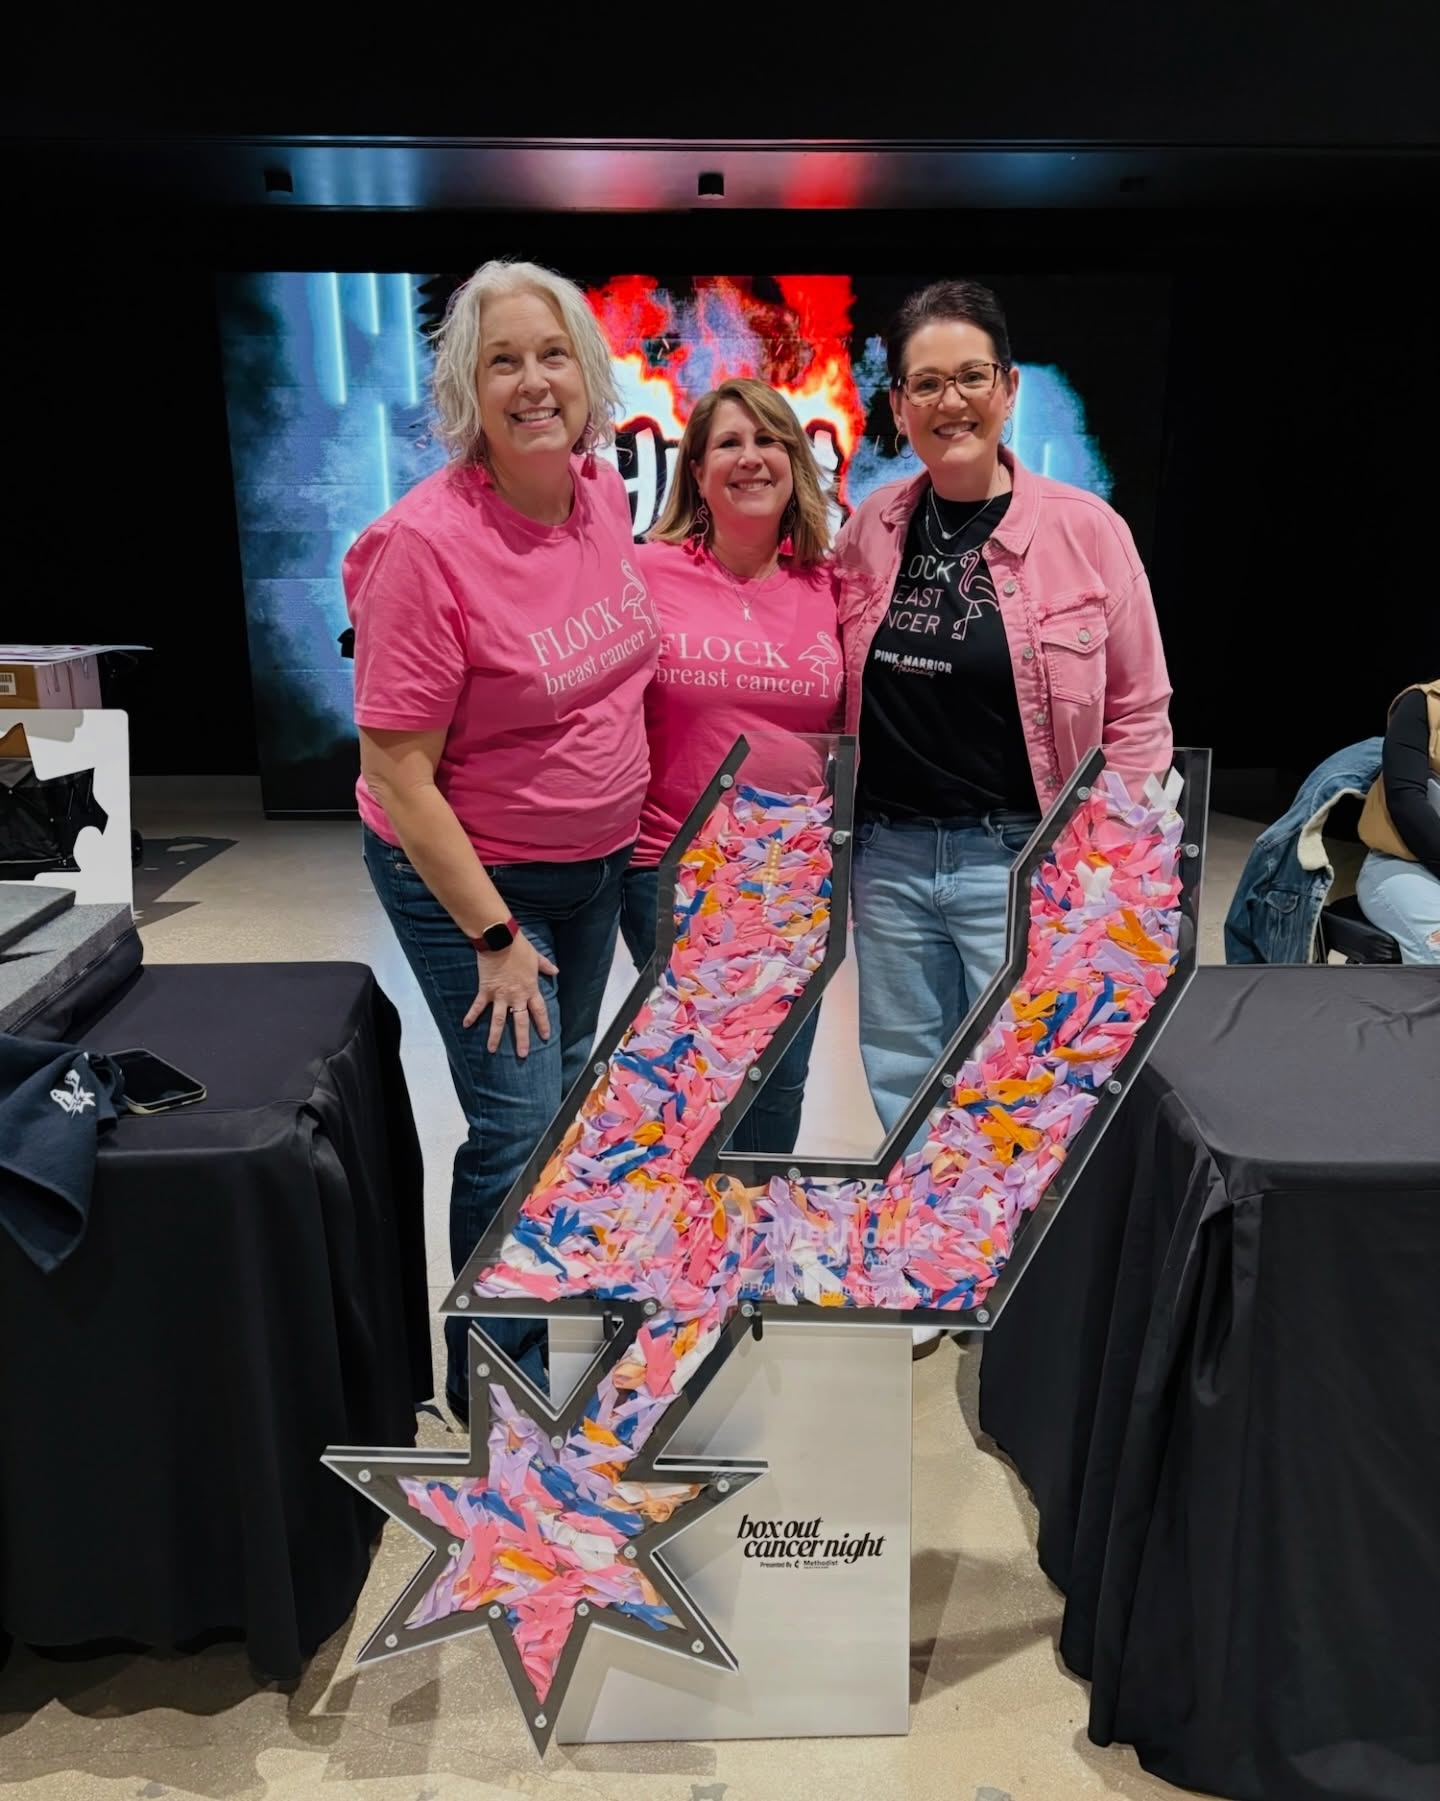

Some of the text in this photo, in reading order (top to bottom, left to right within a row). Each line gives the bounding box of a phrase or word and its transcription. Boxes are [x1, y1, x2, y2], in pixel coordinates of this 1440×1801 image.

[899, 555, 956, 583] OCK
[892, 584, 945, 609] EAST
[528, 597, 623, 667] FLOCK
[887, 609, 941, 636] NCER
[543, 629, 645, 696] breast cancer
[658, 632, 790, 669] FLOCK
[874, 649, 901, 663] PINK
[903, 654, 953, 674] WARRIOR
[657, 665, 815, 697] breast cancer
[737, 1514, 824, 1539] box out
[744, 1532, 886, 1564] cancer night
